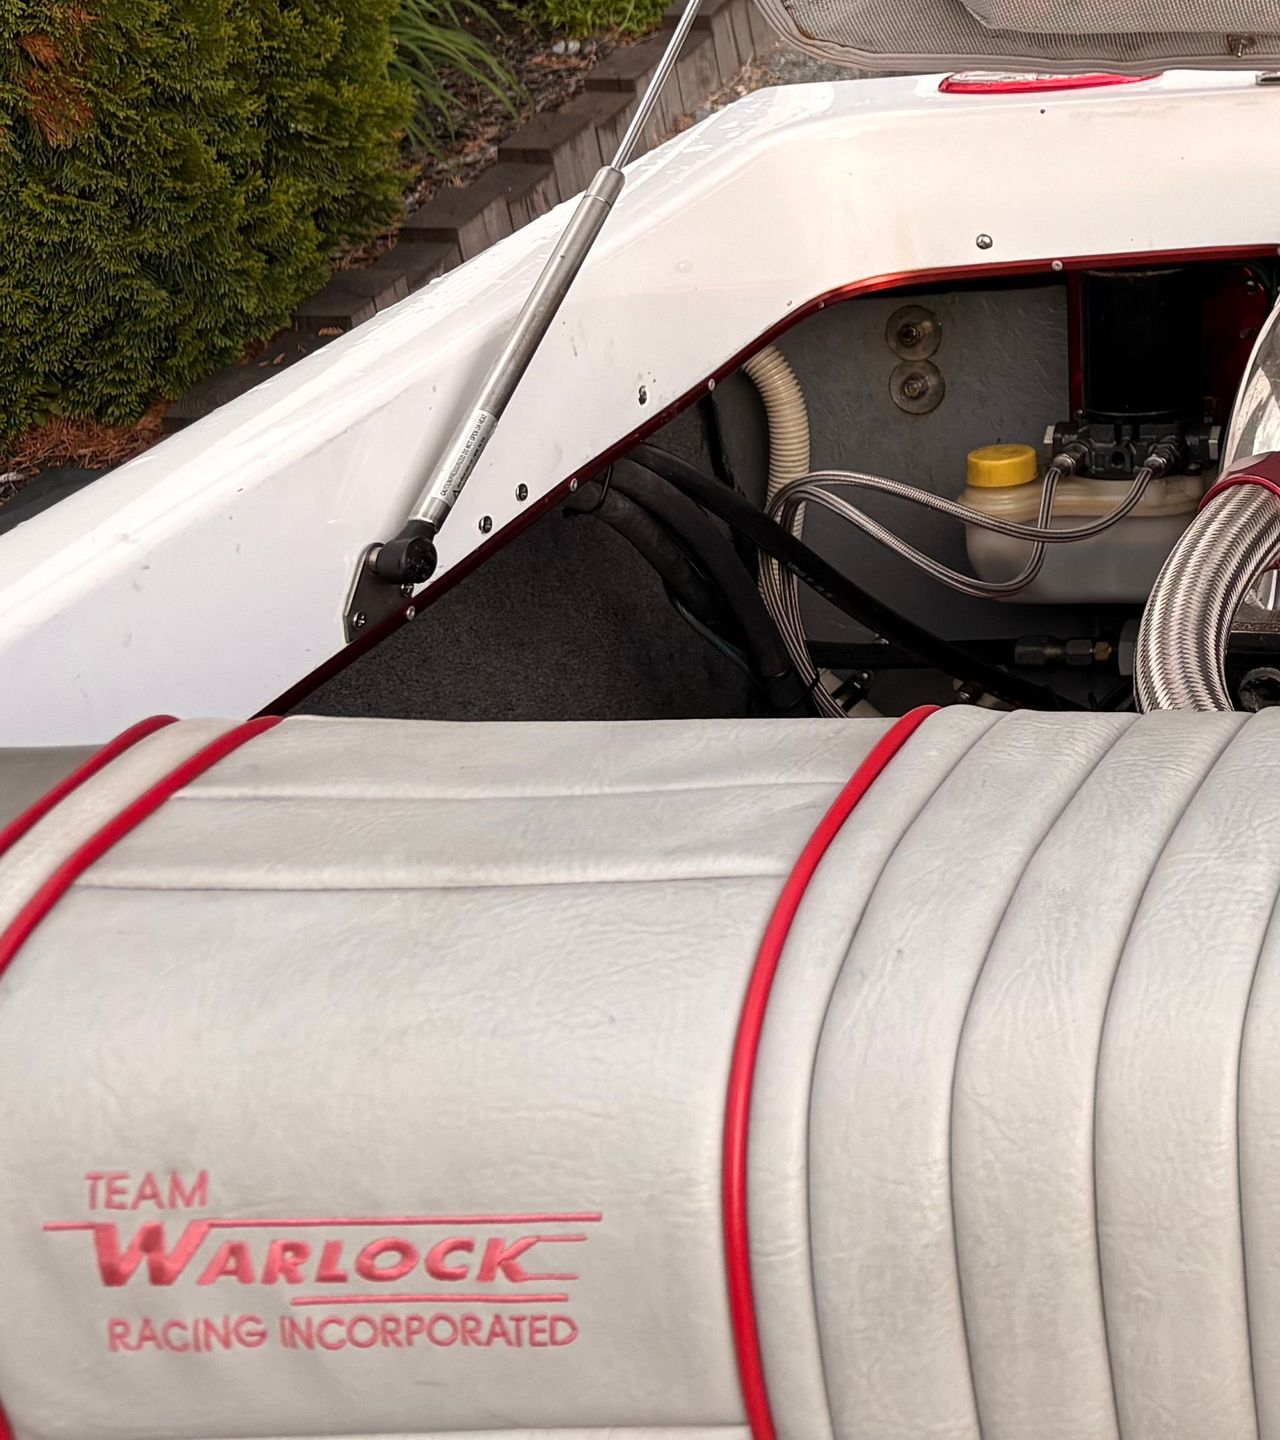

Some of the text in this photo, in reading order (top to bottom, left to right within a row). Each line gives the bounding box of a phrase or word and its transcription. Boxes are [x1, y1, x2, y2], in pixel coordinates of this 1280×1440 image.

[86, 1170, 209, 1211] TEAM
[93, 1219, 545, 1287] WARLOCK
[107, 1312, 580, 1353] RACING INCORPORATED
